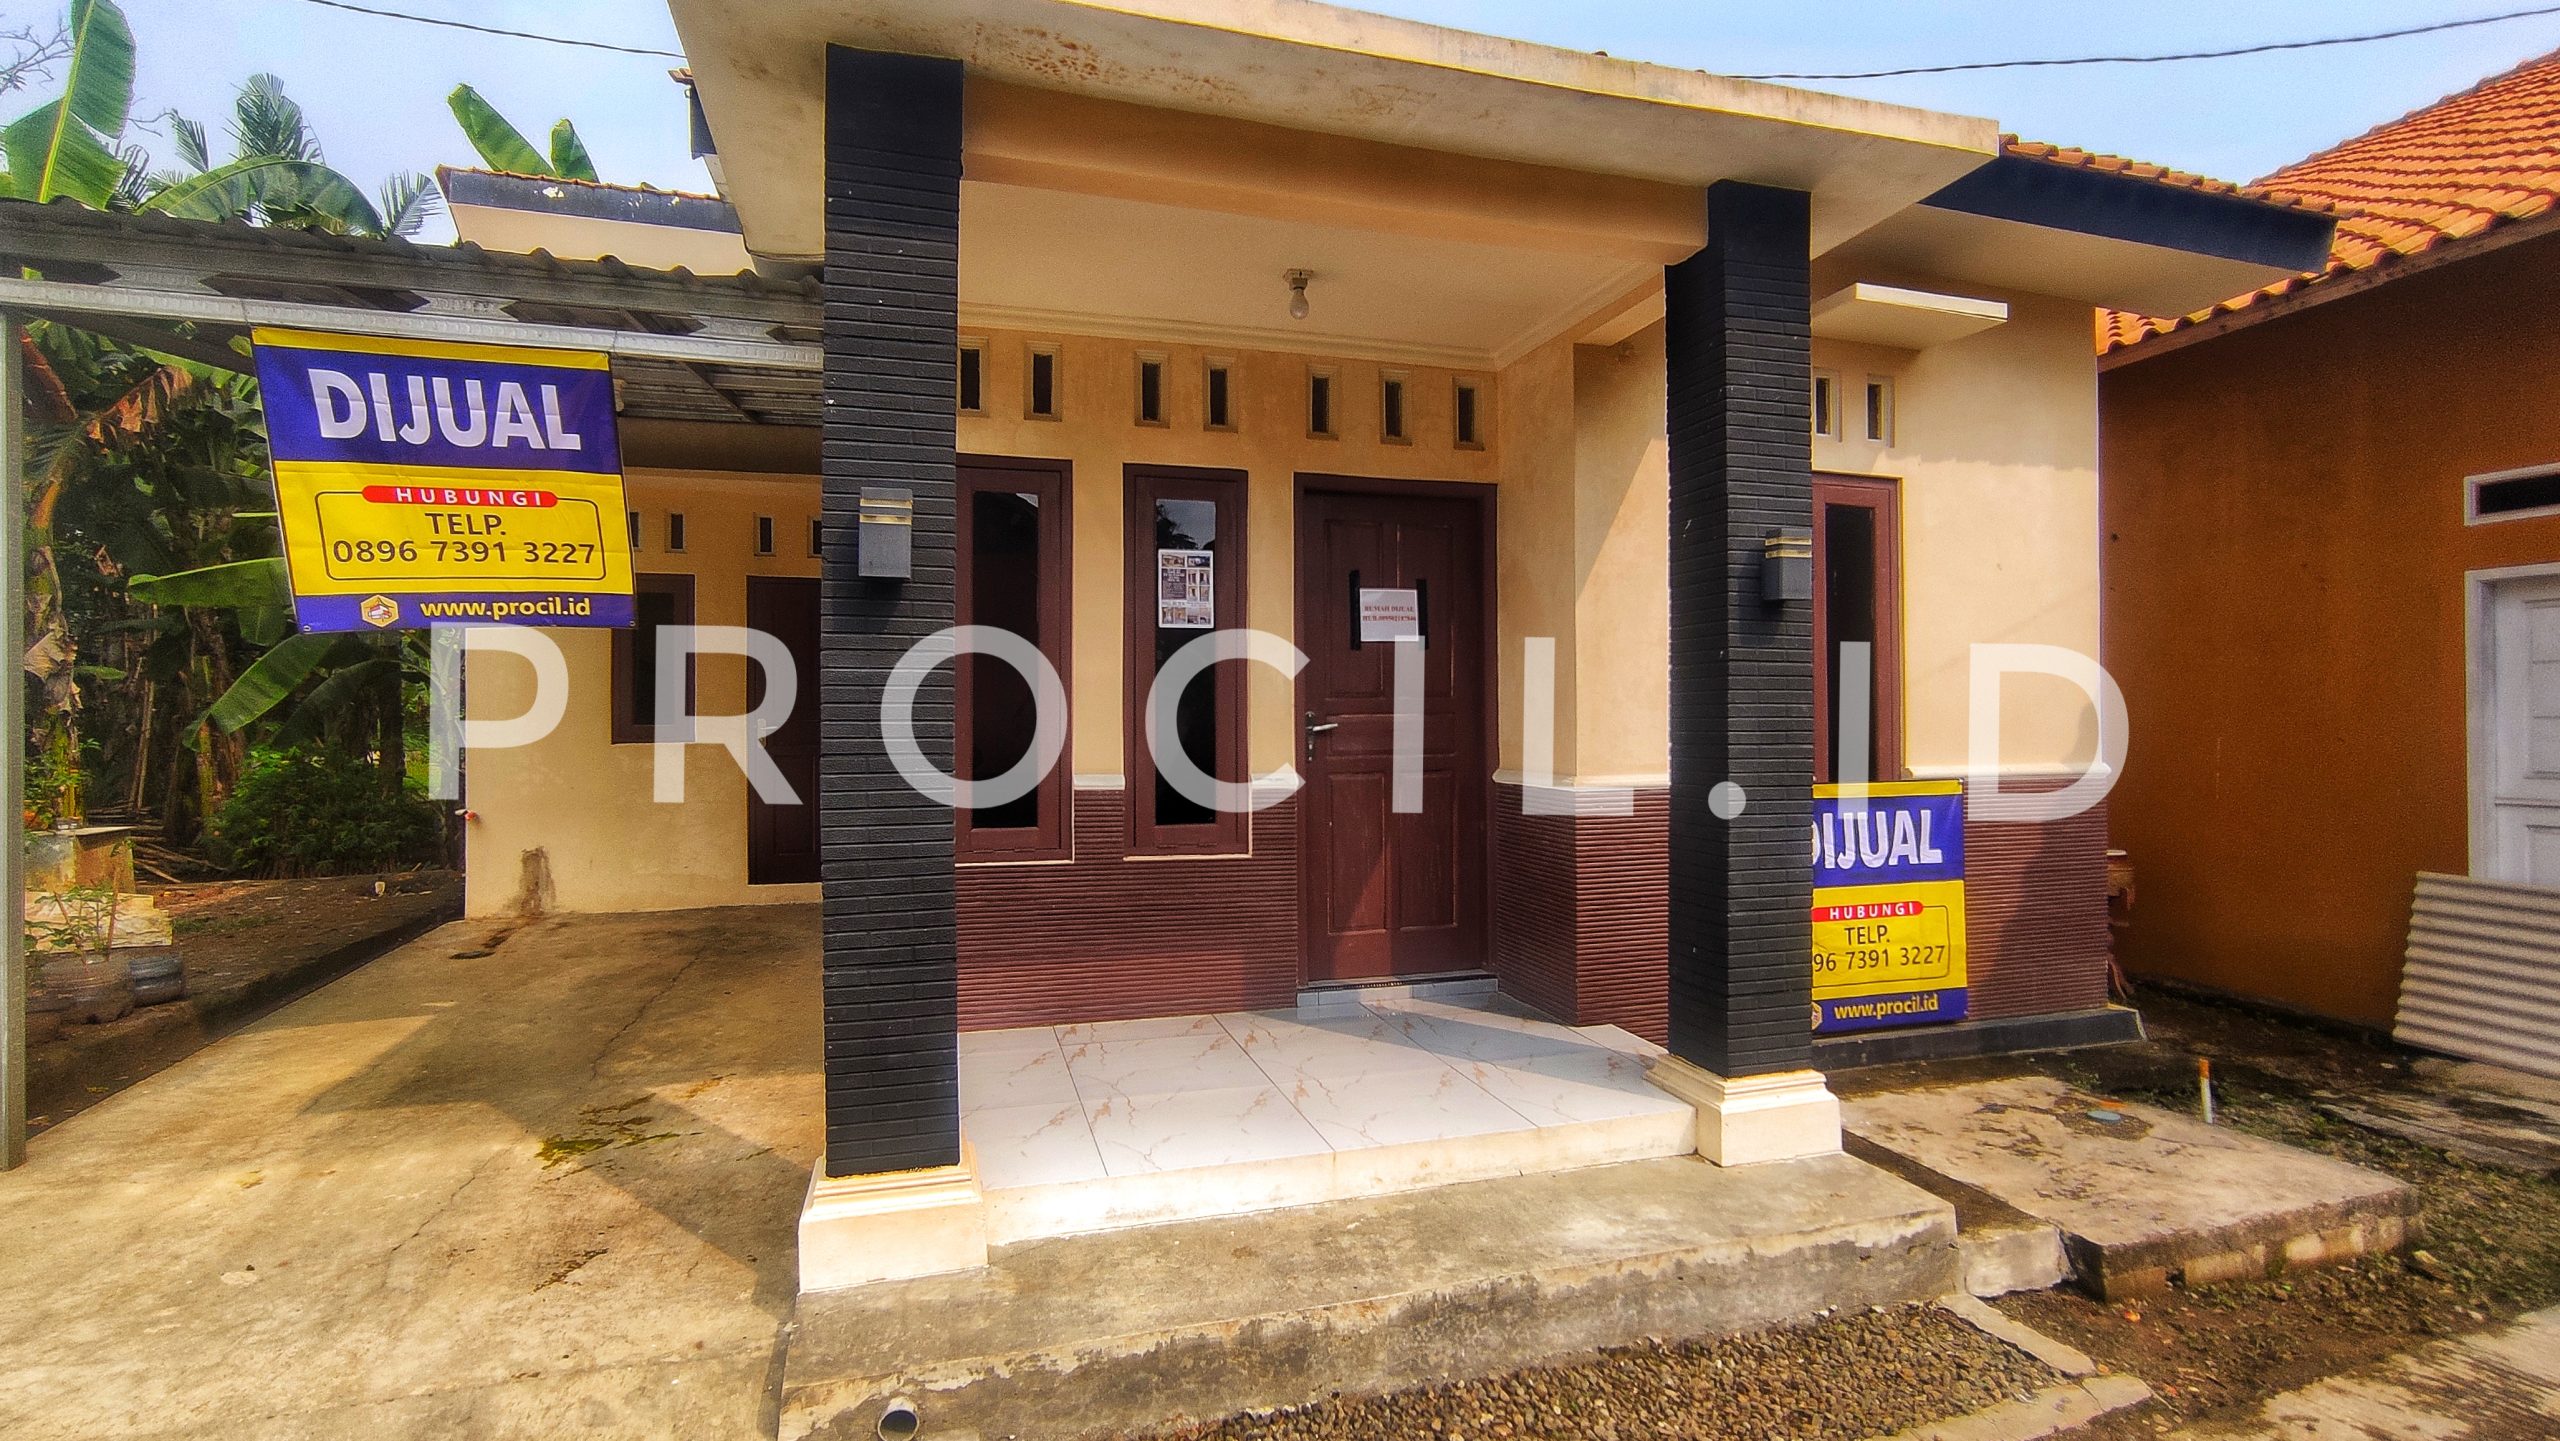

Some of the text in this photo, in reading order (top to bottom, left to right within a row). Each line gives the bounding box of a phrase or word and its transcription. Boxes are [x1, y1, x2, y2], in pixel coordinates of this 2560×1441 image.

[307, 368, 581, 451] DIJUAL
[395, 487, 542, 507] HUBUNGI
[425, 512, 507, 537] TELP.
[333, 539, 595, 565] 0896 7391 3227
[419, 597, 592, 621] www.procil.id
[1829, 902, 1914, 920] HUBUNGI
[1844, 924, 1890, 946] TELP.
[1813, 945, 1945, 973] 96 7391 3227
[1834, 994, 1940, 1021] www.procil.id
